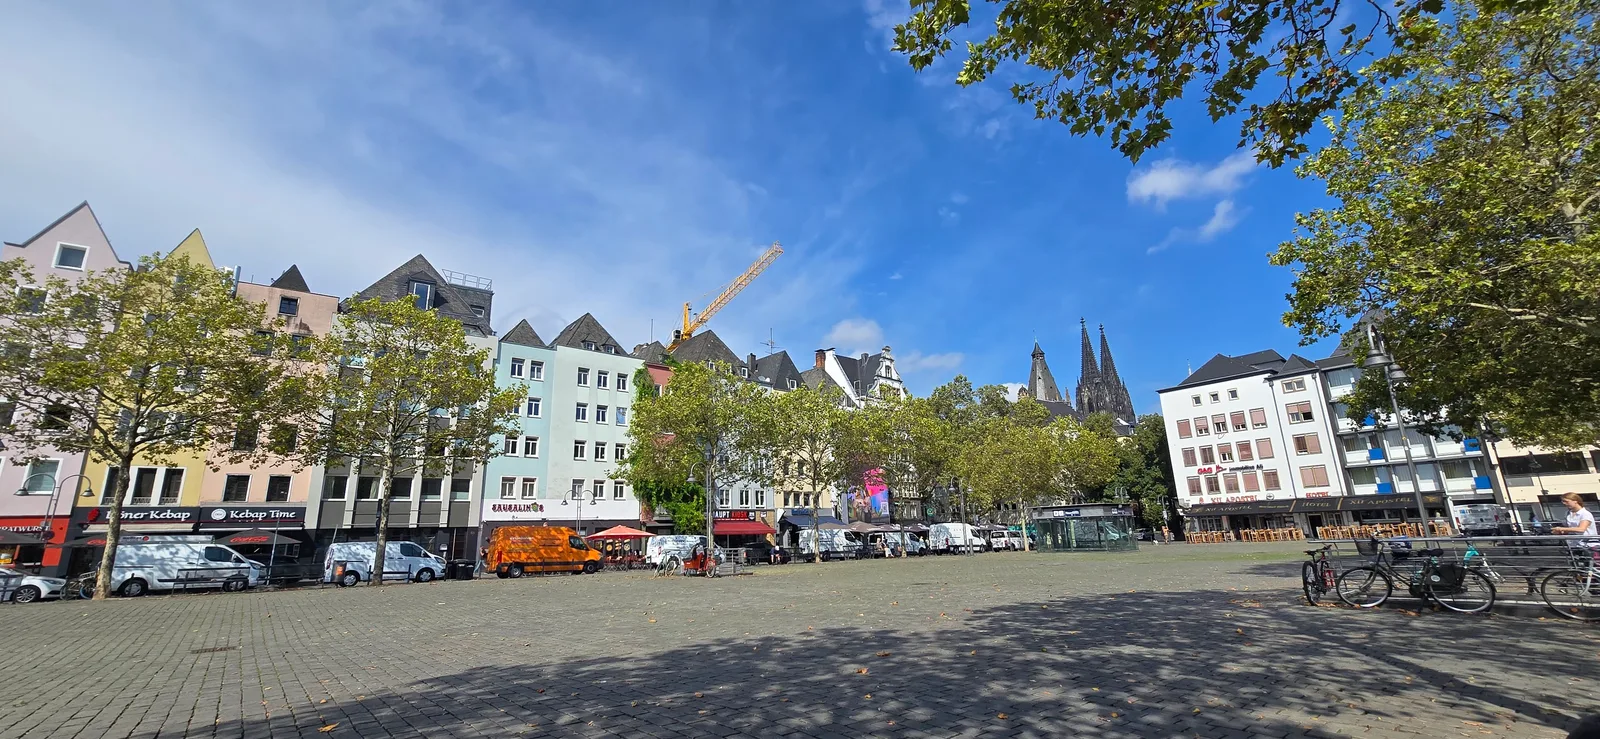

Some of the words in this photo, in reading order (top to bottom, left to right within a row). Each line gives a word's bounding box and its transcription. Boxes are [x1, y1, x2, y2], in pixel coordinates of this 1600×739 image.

[149, 509, 191, 521] Kebap
[230, 509, 267, 520] Kebap
[269, 510, 296, 518] Time
